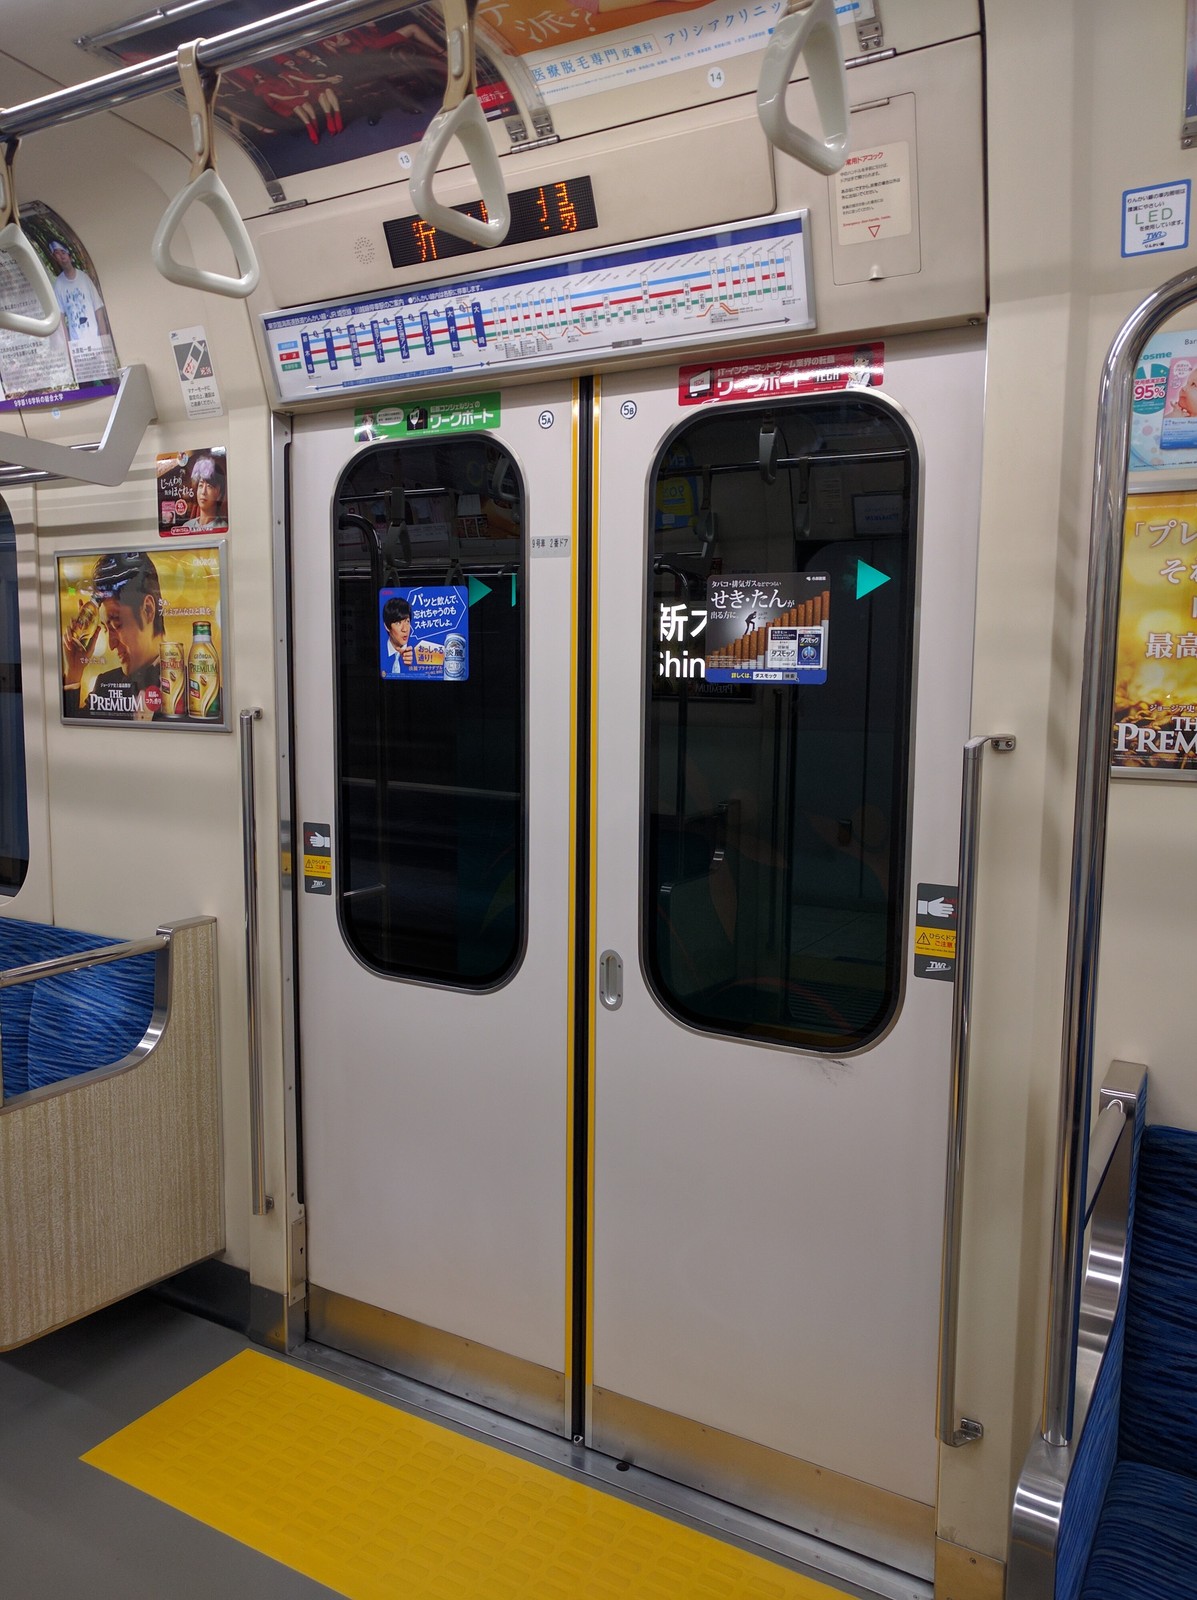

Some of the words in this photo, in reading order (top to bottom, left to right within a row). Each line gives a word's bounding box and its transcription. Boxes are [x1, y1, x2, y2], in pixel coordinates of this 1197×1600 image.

[532, 48, 619, 82] 医療脱毛専門
[622, 41, 653, 58] 皮膚科
[710, 72, 722, 82] 14
[400, 154, 410, 164] 13
[1135, 207, 1173, 225] LED
[1140, 351, 1172, 361] osme
[1134, 384, 1165, 400] 95%
[411, 592, 460, 607] パッと飲んで、
[710, 588, 795, 609] せき・たんが
[413, 606, 457, 619] 忘れちゃうのも
[414, 619, 453, 630] スキルでしょ。
[418, 645, 444, 655] おっしゃる
[1145, 632, 1197, 659] 最高
[418, 654, 433, 663] 通り!
[190, 663, 218, 675] PREMIUM
[108, 689, 123, 700] THE
[89, 693, 144, 713] PREMIUM
[1149, 703, 1195, 713] ジョージア史
